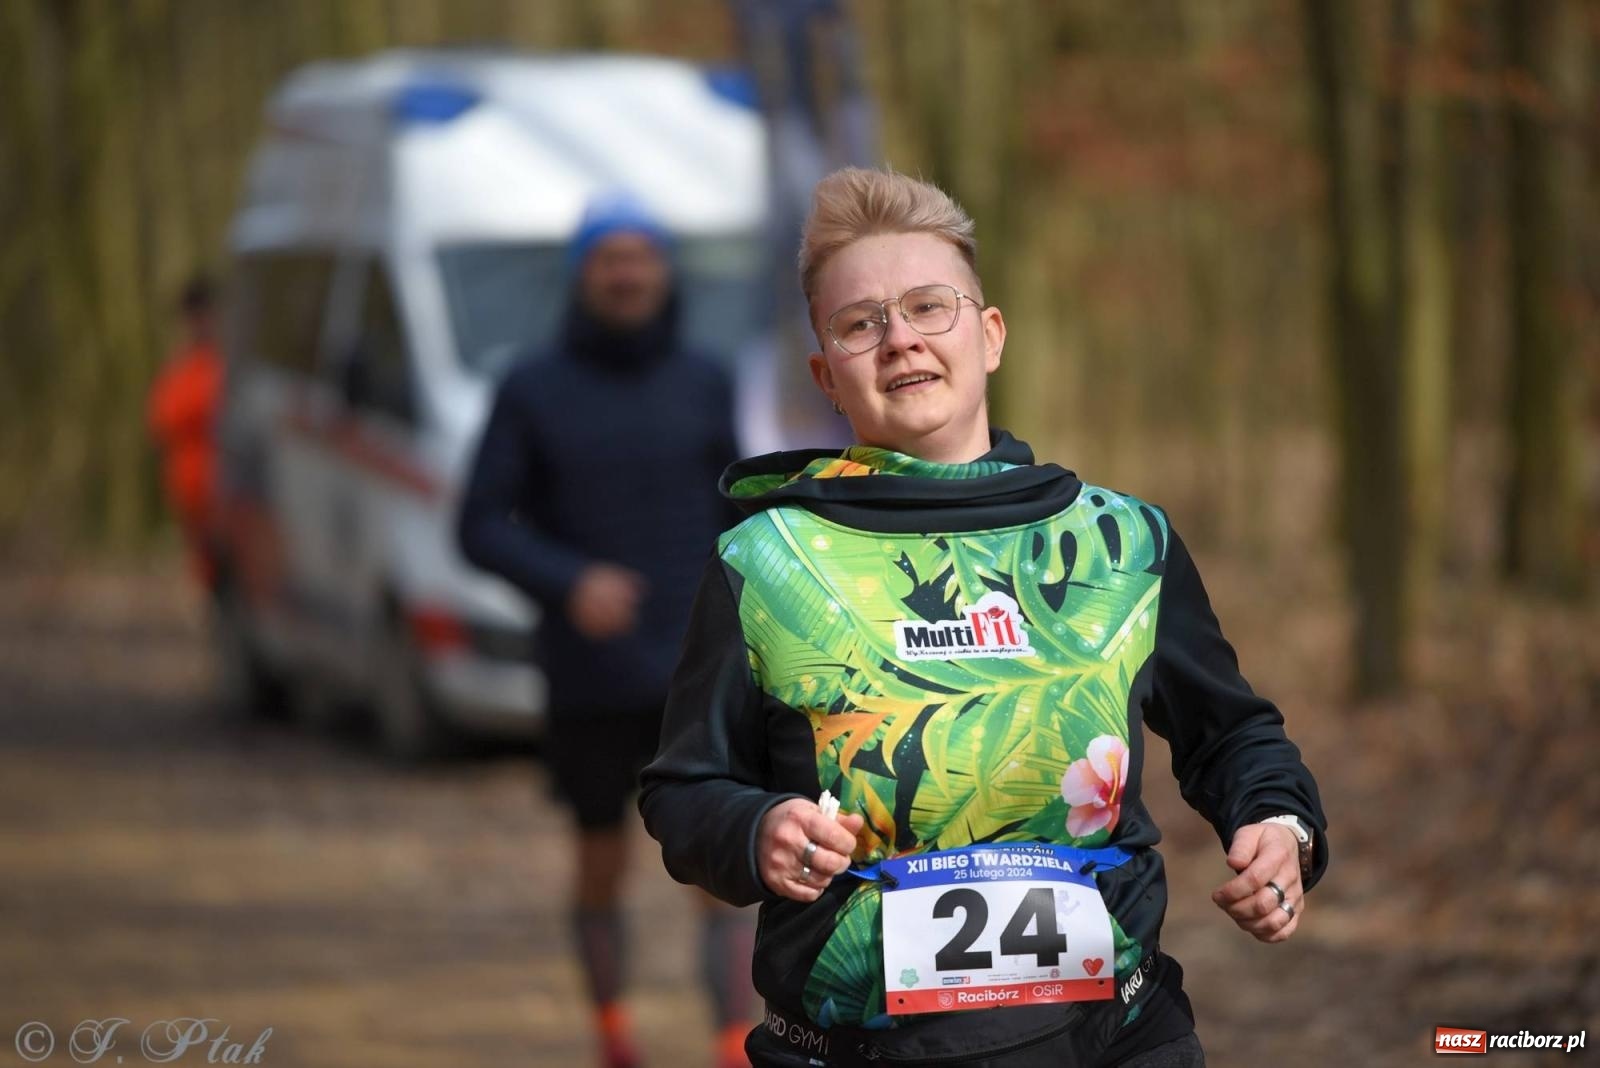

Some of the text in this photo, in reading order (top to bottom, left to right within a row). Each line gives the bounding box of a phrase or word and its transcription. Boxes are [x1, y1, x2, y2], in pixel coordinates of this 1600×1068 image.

[907, 852, 1073, 874] XII BIEG TWARDZIELA
[954, 868, 1033, 881] 25 lutego 2024
[932, 887, 1068, 972] 24
[957, 984, 1063, 1004] Racibórz OSiR
